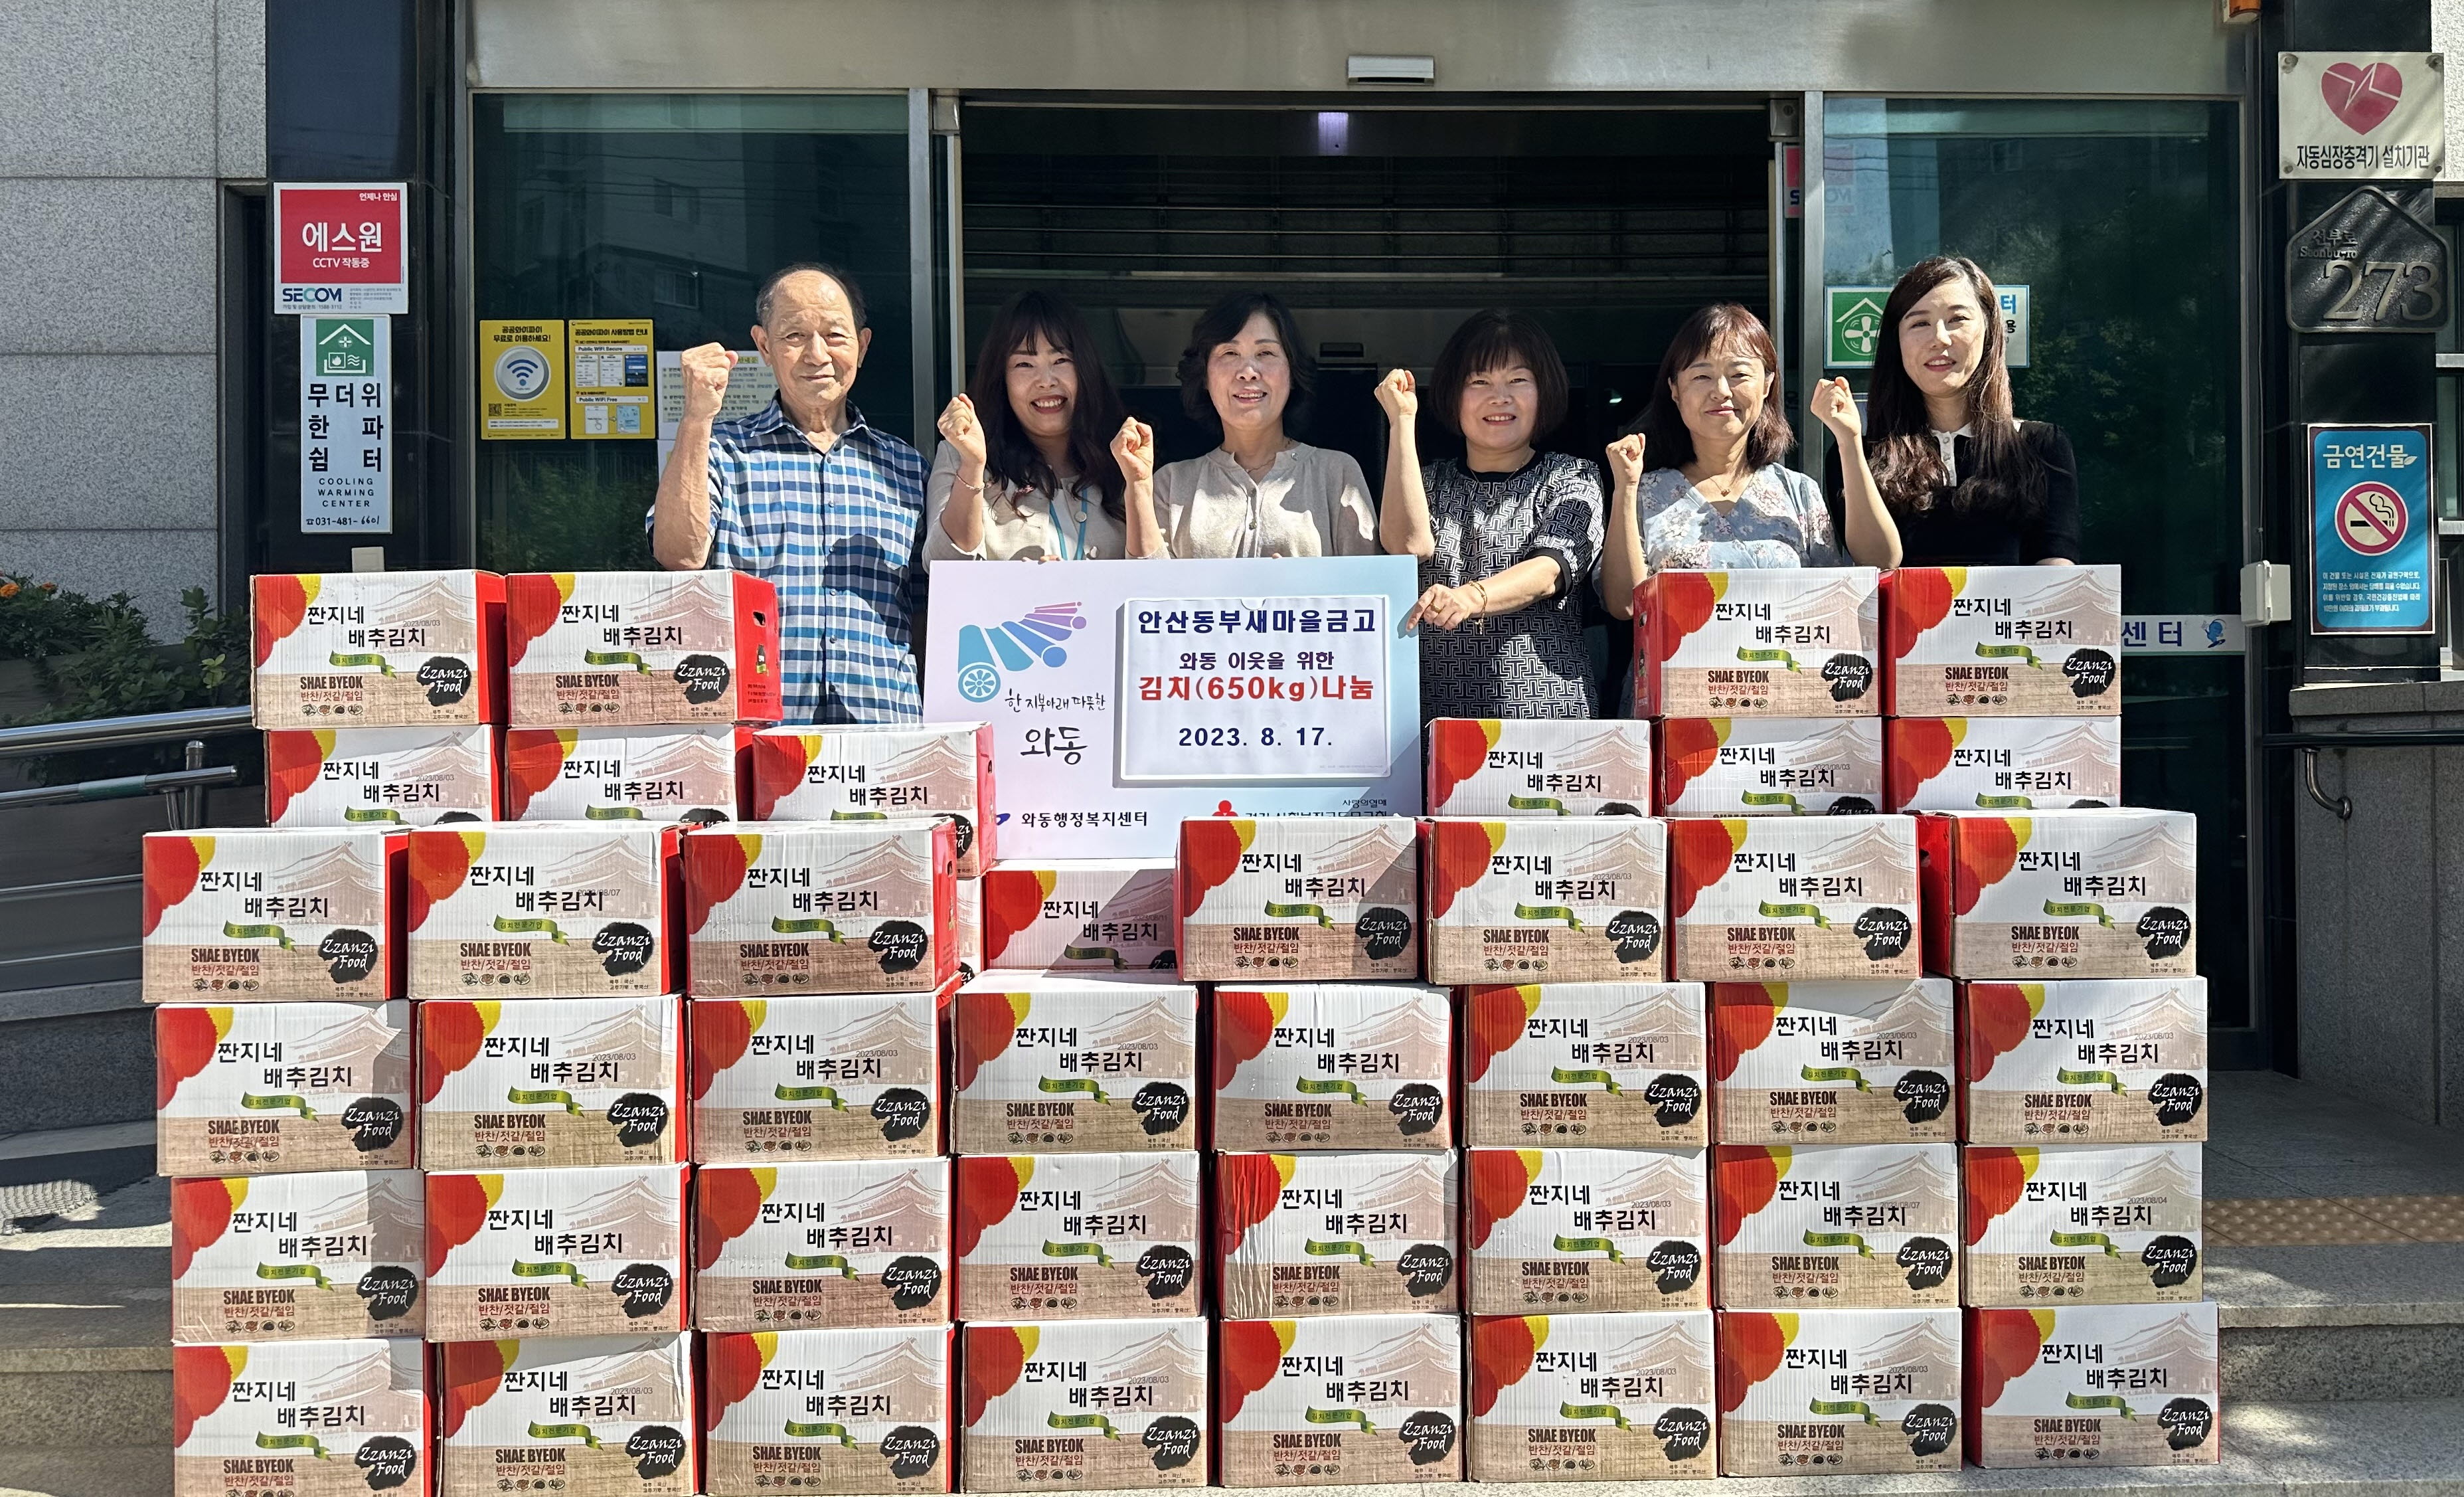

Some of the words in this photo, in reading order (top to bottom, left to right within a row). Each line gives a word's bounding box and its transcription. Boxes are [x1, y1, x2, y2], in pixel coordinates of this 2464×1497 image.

[2297, 145, 2378, 169] 자동심장충격기
[2383, 145, 2429, 169] 설치기관
[359, 193, 381, 201] 언제나
[302, 222, 382, 252] 에스원
[313, 258, 340, 268] CCTV
[342, 258, 370, 268] 작동중
[283, 288, 342, 302] SECOM
[2324, 260, 2441, 321] 273
[2323, 444, 2408, 469] 금연건물
[307, 606, 365, 624] 짠지네
[561, 604, 619, 622] 짠지네
[1715, 602, 1771, 621] 짠지네
[1953, 598, 2011, 616] 짠지네
[1138, 609, 1375, 634] 안산동부새마을금고
[1995, 620, 2072, 640] 배추김치
[349, 628, 425, 648] 배추김치
[604, 626, 681, 646] 배추김치
[1756, 624, 1830, 644] 배추김치
[1180, 652, 1216, 670] 와동
[1228, 652, 1285, 670] 이웃을
[1297, 652, 1334, 669] 위한
[420, 664, 467, 679] Zzanzi
[300, 676, 327, 689] SHAE
[329, 676, 363, 689] BYEOK
[436, 678, 463, 695] Food
[1138, 675, 1374, 701] 김치(650kg)나눔
[300, 691, 363, 701] 반찬/젓갈/절임
[1005, 688, 1022, 713] 한
[1071, 693, 1106, 711] 따뜻한
[1021, 727, 1089, 765] 와동
[1179, 727, 1247, 747] 2023.
[1261, 727, 1281, 747] 8.
[1297, 727, 1333, 747] 17.
[1487, 750, 1543, 769] 짠지네
[1719, 747, 1775, 764] 짠지네
[1953, 748, 2011, 767] 짠지네
[323, 762, 379, 780] 짠지네
[562, 760, 621, 778] 짠지네
[807, 765, 866, 783] 짠지네
[1760, 768, 1834, 788] 배추김치
[1527, 772, 1601, 794] 배추김치
[1995, 770, 2071, 790] 배추김치
[364, 783, 439, 802] 배추김치
[605, 780, 683, 801] 배추김치
[850, 786, 927, 806] 배추김치
[1021, 812, 1148, 828] 와동행정복지센터
[1242, 853, 1301, 873] 짠지네
[1734, 853, 1796, 872] 짠지네
[200, 871, 262, 892] 짠지네
[747, 868, 810, 887] 짠지네
[1285, 876, 1365, 898] 배추김치
[1779, 876, 1862, 897] 배추김치
[2064, 875, 2146, 897] 배추김치
[245, 895, 328, 919] 배추김치
[793, 891, 877, 912] 배추김치
[1043, 901, 1100, 917] 짠지네
[597, 930, 650, 947] Zzanzi
[1483, 944, 1548, 956] 반찬/젓갈/절임
[1015, 1027, 1078, 1047] 짠지네
[1273, 1027, 1335, 1048] 짠지네
[1527, 1018, 1588, 1038] 짠지네
[2032, 1019, 2094, 1039] 짠지네
[483, 1037, 550, 1057] 짠지네
[1572, 1041, 1653, 1064] 배추김치
[2078, 1042, 2159, 1065] 배추김치
[531, 1061, 618, 1083] 배추김치
[1060, 1051, 1142, 1073] 배추김치
[264, 1066, 351, 1088] 배추김치
[875, 1097, 926, 1112] Zzanzi
[1770, 1107, 1837, 1118] 반찬/젓갈/절임
[1281, 1189, 1343, 1209] 짠지네
[1778, 1180, 1841, 1201] 짠지네
[2026, 1182, 2087, 1201] 짠지네
[232, 1212, 297, 1233] 짠지네
[761, 1203, 825, 1223] 짠지네
[1824, 1205, 1906, 1227] 배추김치
[1064, 1214, 1146, 1235] 배추김치
[1326, 1213, 1407, 1235] 배추김치
[279, 1235, 367, 1258] 배추김치
[807, 1225, 892, 1248] 배추김치
[1650, 1249, 1699, 1265] Zzanzi
[478, 1303, 550, 1315] 반찬/젓갈/절임
[1535, 1352, 1598, 1372] 짠지네
[2042, 1344, 2103, 1364] 짠지네
[503, 1371, 568, 1391] 짠지네
[1024, 1362, 1087, 1381] 짠지네
[2087, 1367, 2167, 1389] 배추김치
[231, 1381, 296, 1401] 짠지네
[1069, 1385, 1153, 1407] 배추김치
[1327, 1380, 1408, 1402] 배추김치
[1581, 1375, 1663, 1399] 배추김치
[550, 1395, 635, 1417] 배추김치
[1906, 1413, 1955, 1429] Zzanzi
[752, 1462, 821, 1474] 반찬/젓갈/절임
